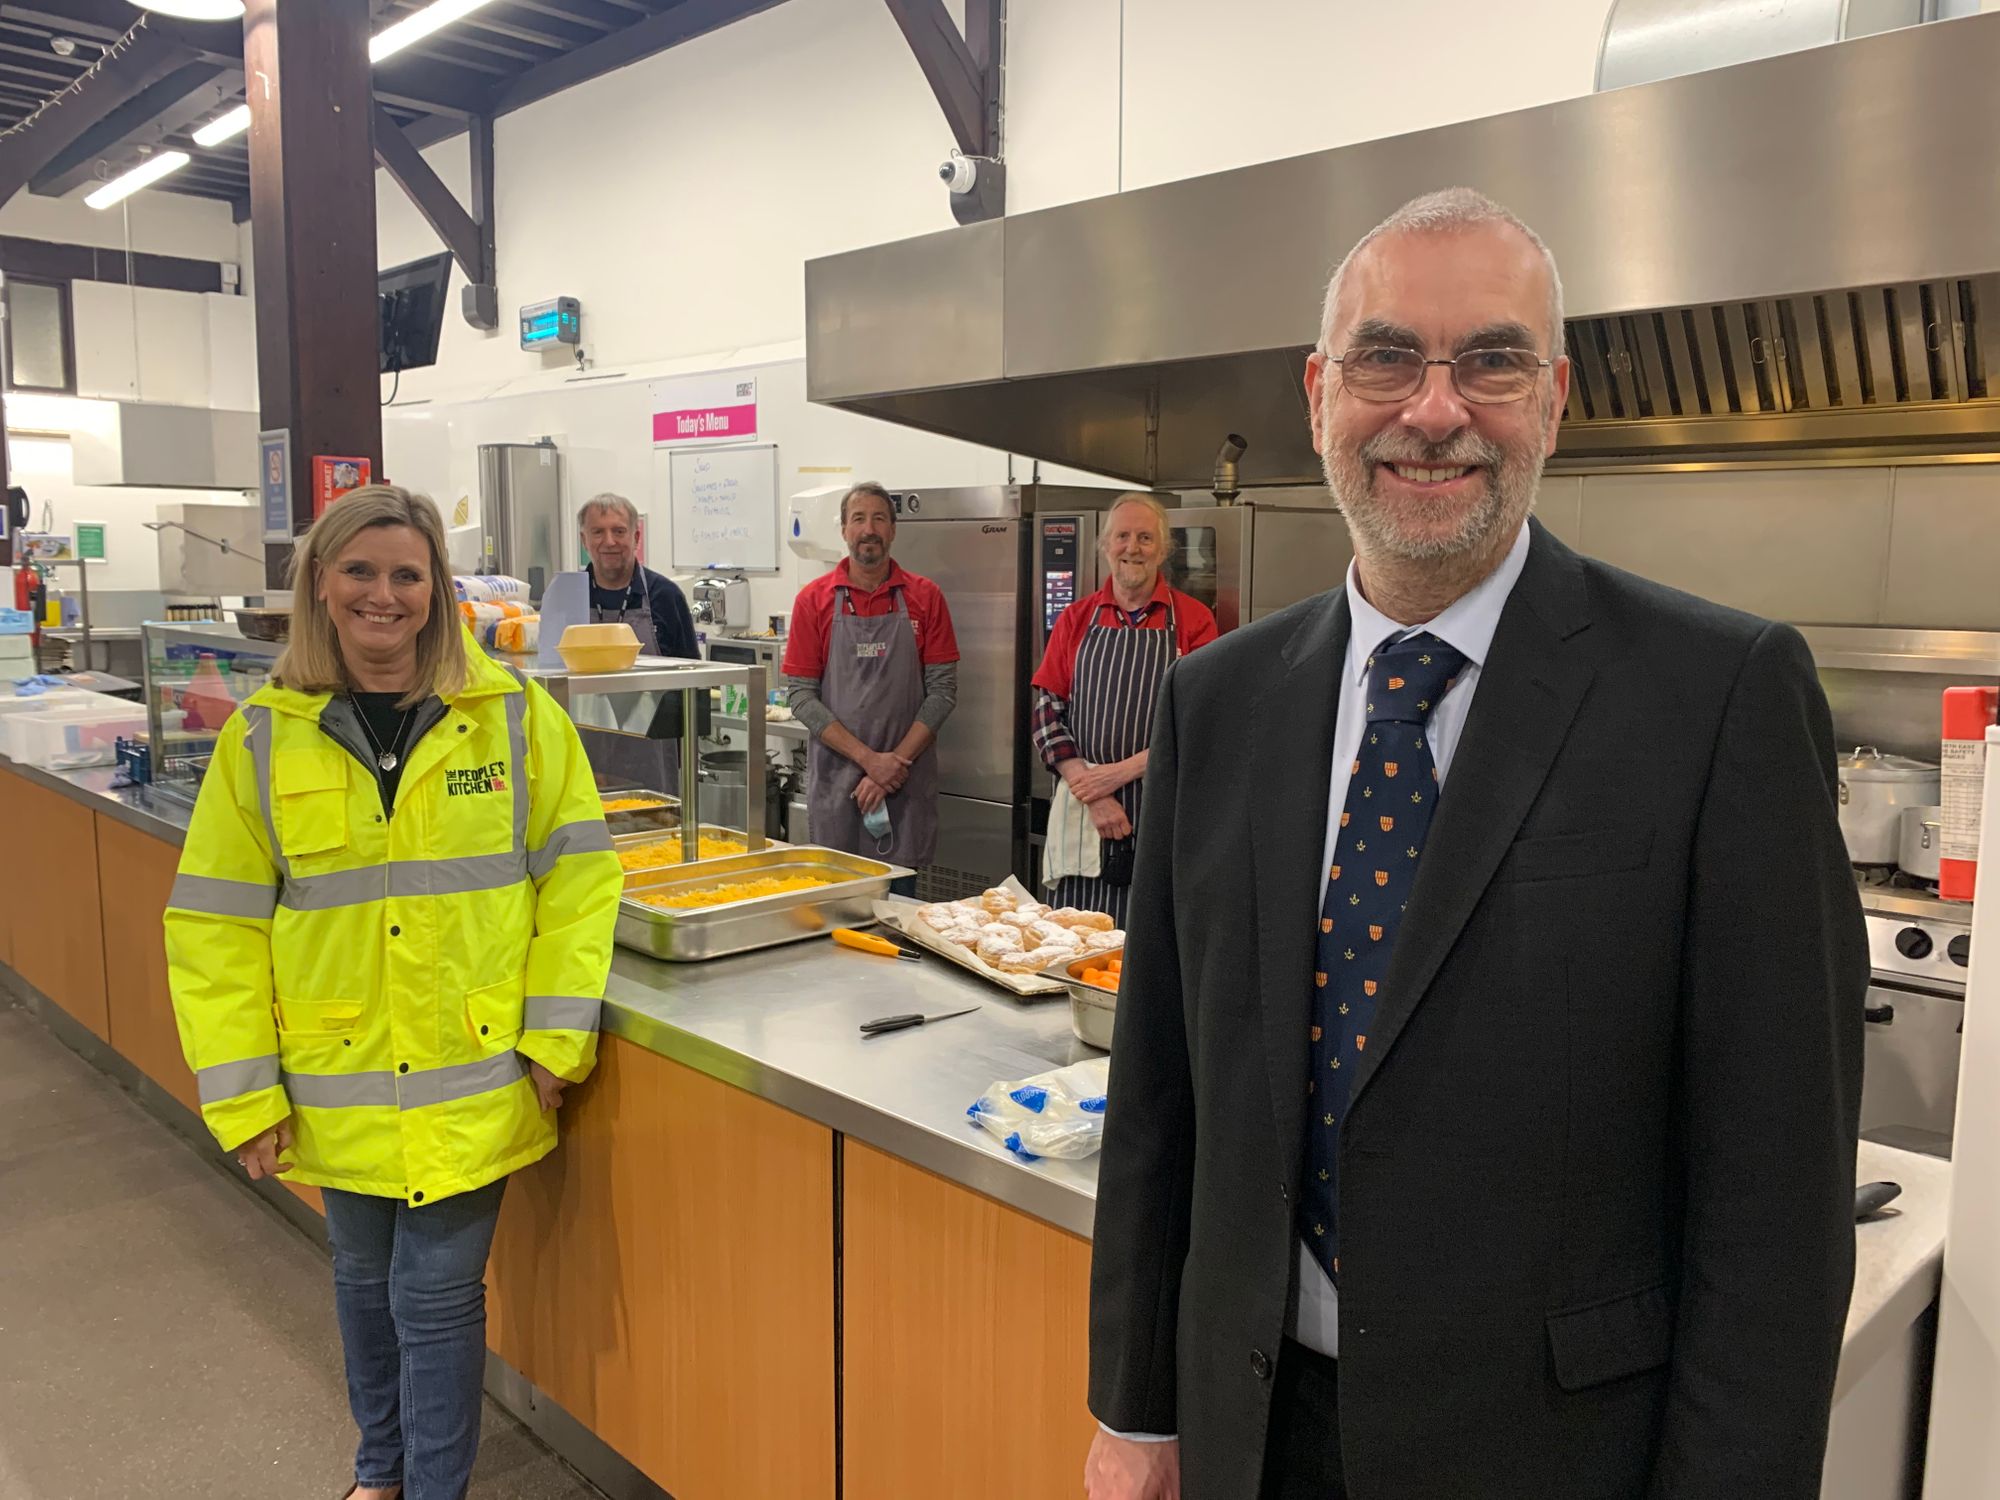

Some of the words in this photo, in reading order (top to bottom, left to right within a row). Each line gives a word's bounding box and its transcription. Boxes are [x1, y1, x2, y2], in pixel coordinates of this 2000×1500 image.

[676, 413, 704, 437] Today's
[706, 412, 729, 431] Menu
[324, 464, 332, 498] BLANKET
[457, 761, 505, 782] PEOPLE'S
[447, 778, 493, 797] KITCHEN
